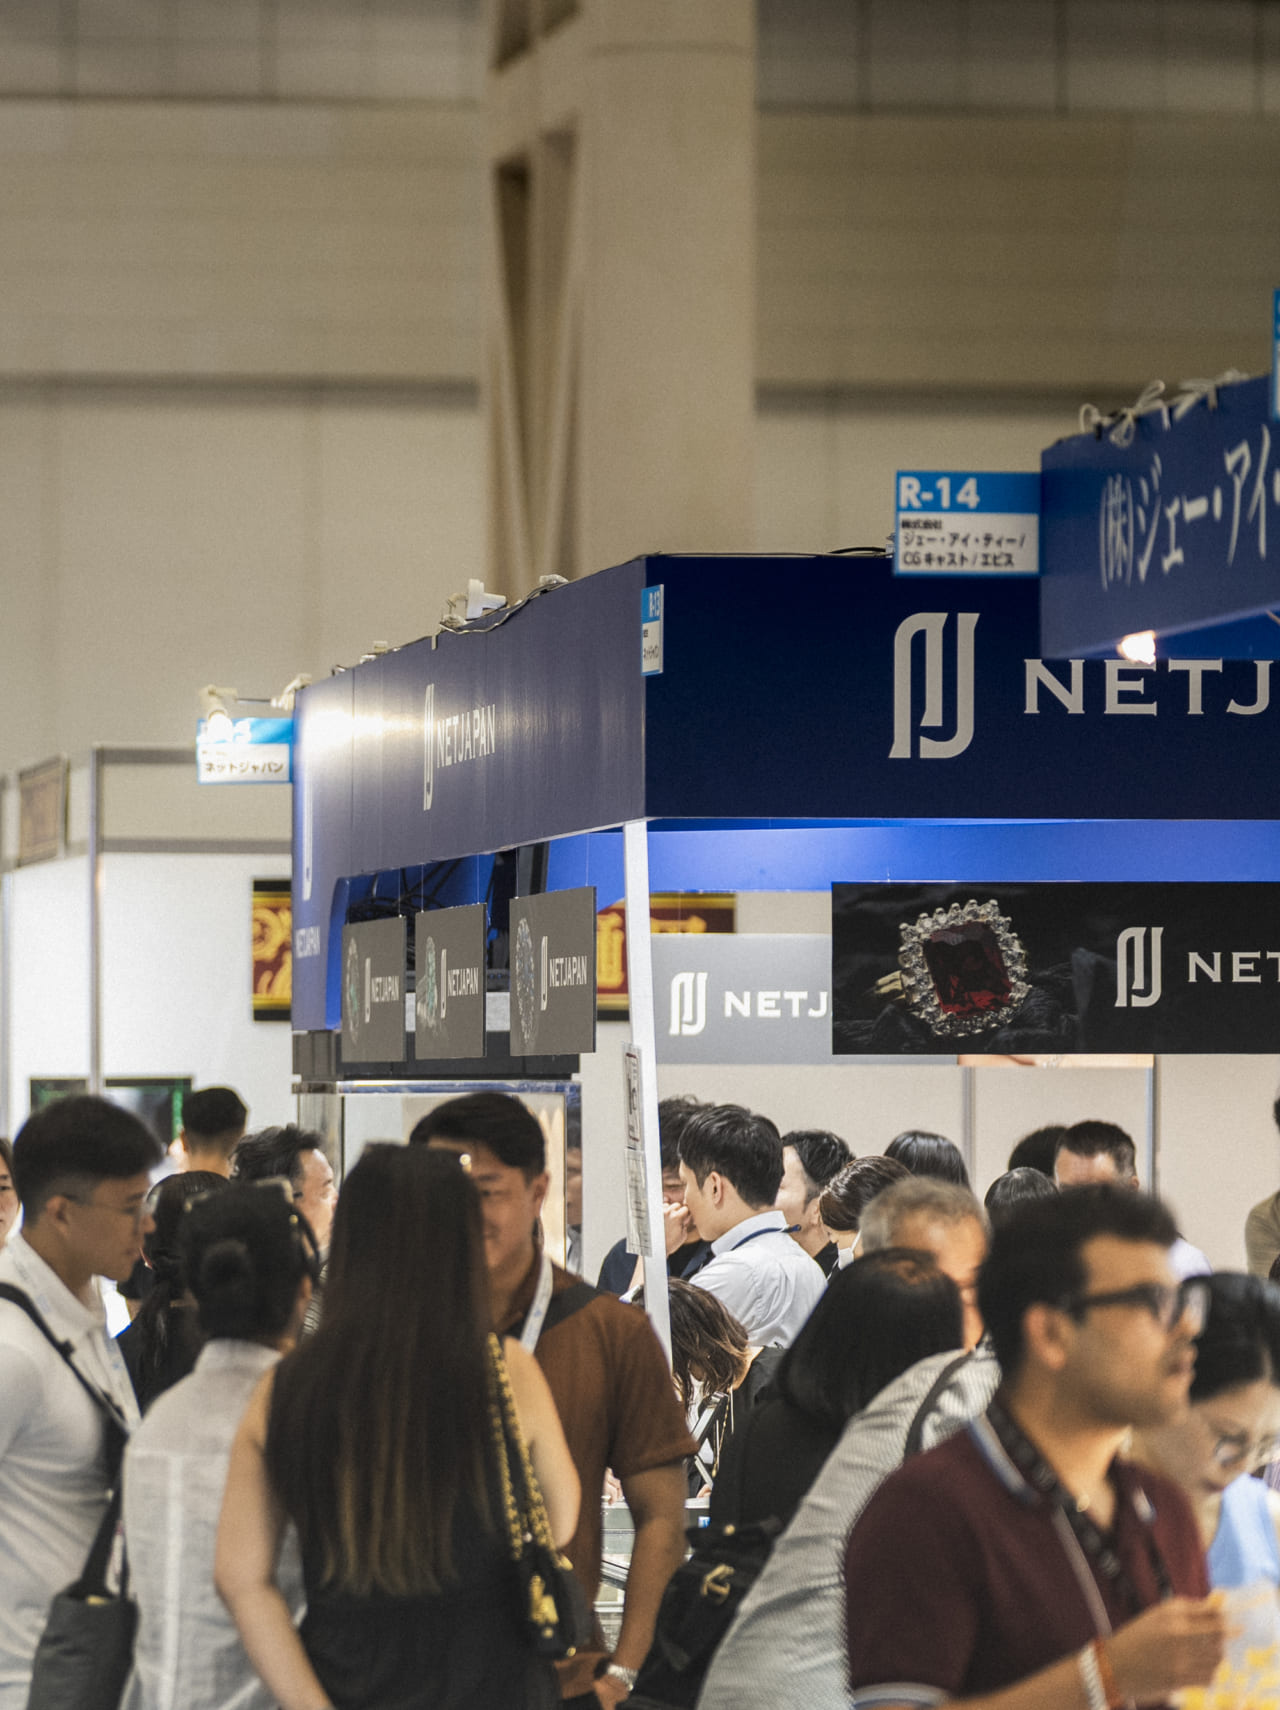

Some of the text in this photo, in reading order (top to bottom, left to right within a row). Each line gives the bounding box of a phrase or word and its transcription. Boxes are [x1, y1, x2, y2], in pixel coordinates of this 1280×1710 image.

[899, 477, 980, 509] R-14
[436, 704, 495, 769] NETJAPAN
[447, 967, 479, 997] NETJAPAN
[548, 955, 587, 988] NETJAPAN
